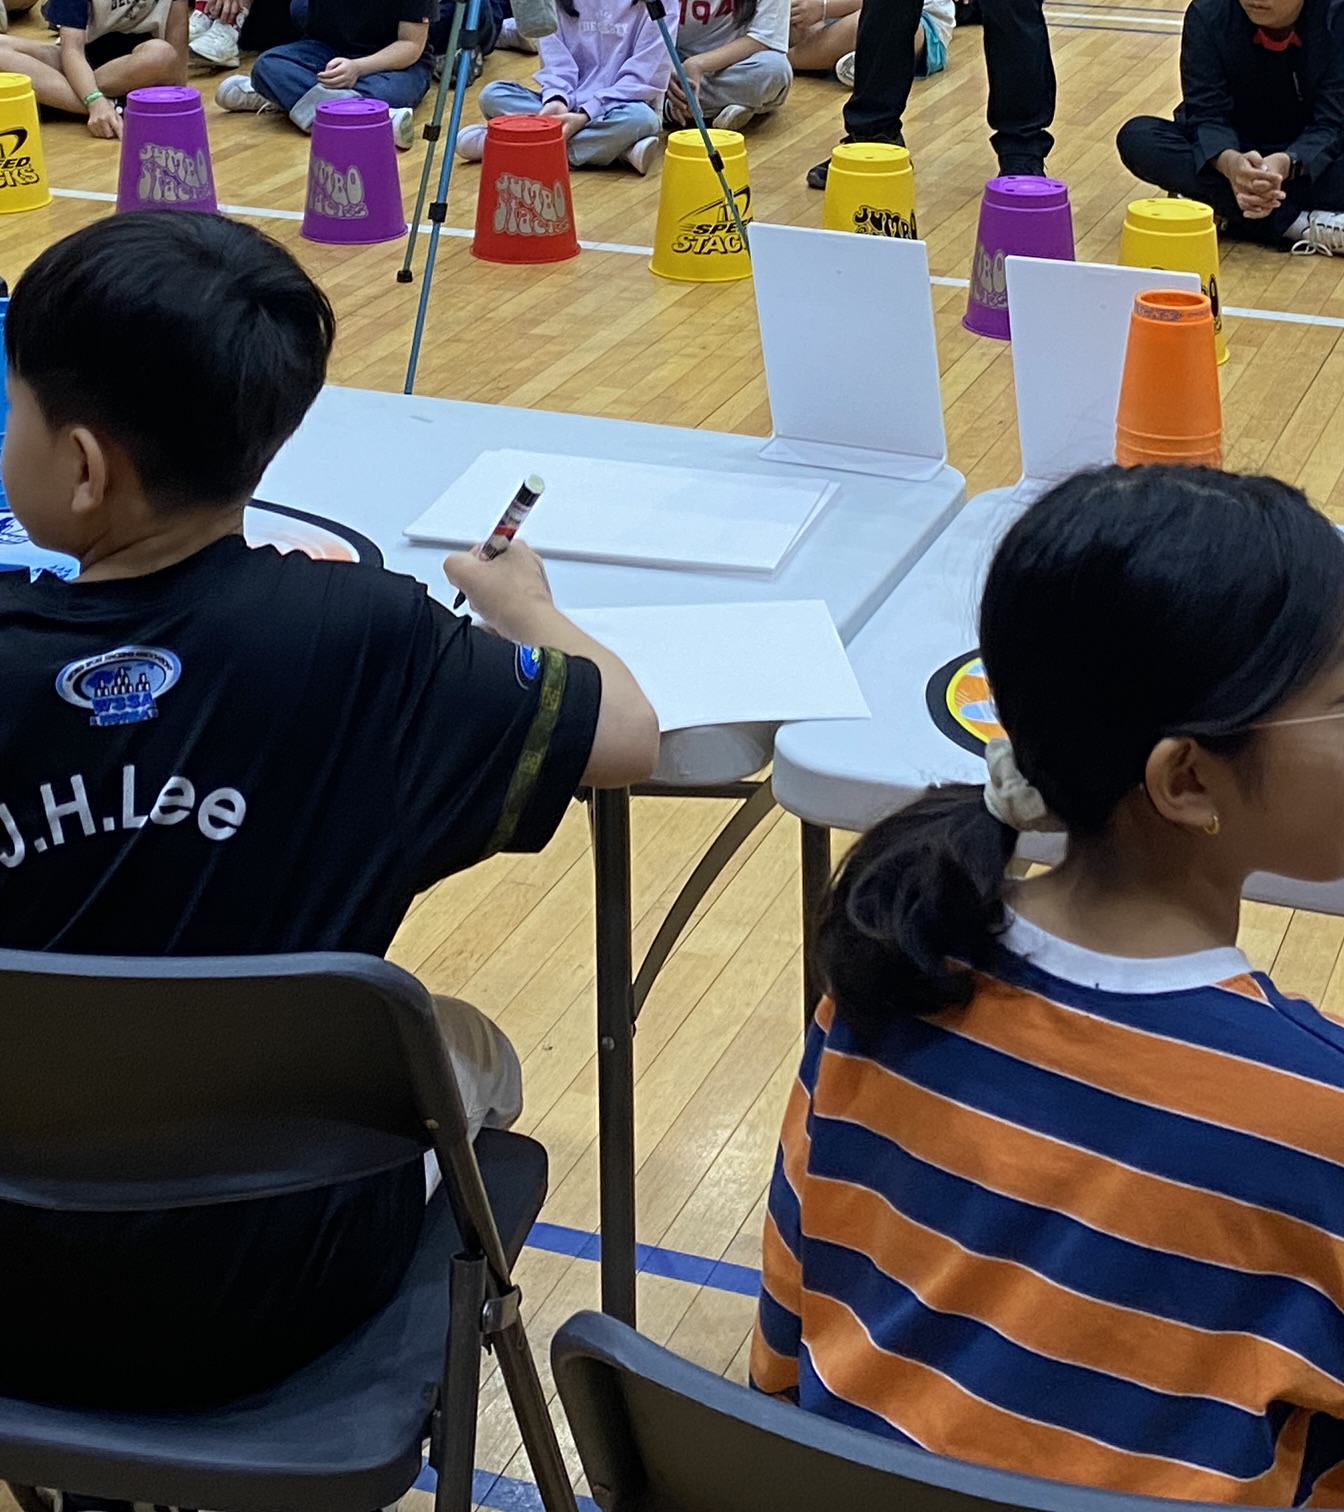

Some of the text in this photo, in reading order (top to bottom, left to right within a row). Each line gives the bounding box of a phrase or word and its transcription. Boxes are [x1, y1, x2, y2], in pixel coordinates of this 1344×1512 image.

[139, 143, 207, 188] JUMBO
[494, 172, 565, 222] JUMBO
[93, 691, 153, 714] WSSA
